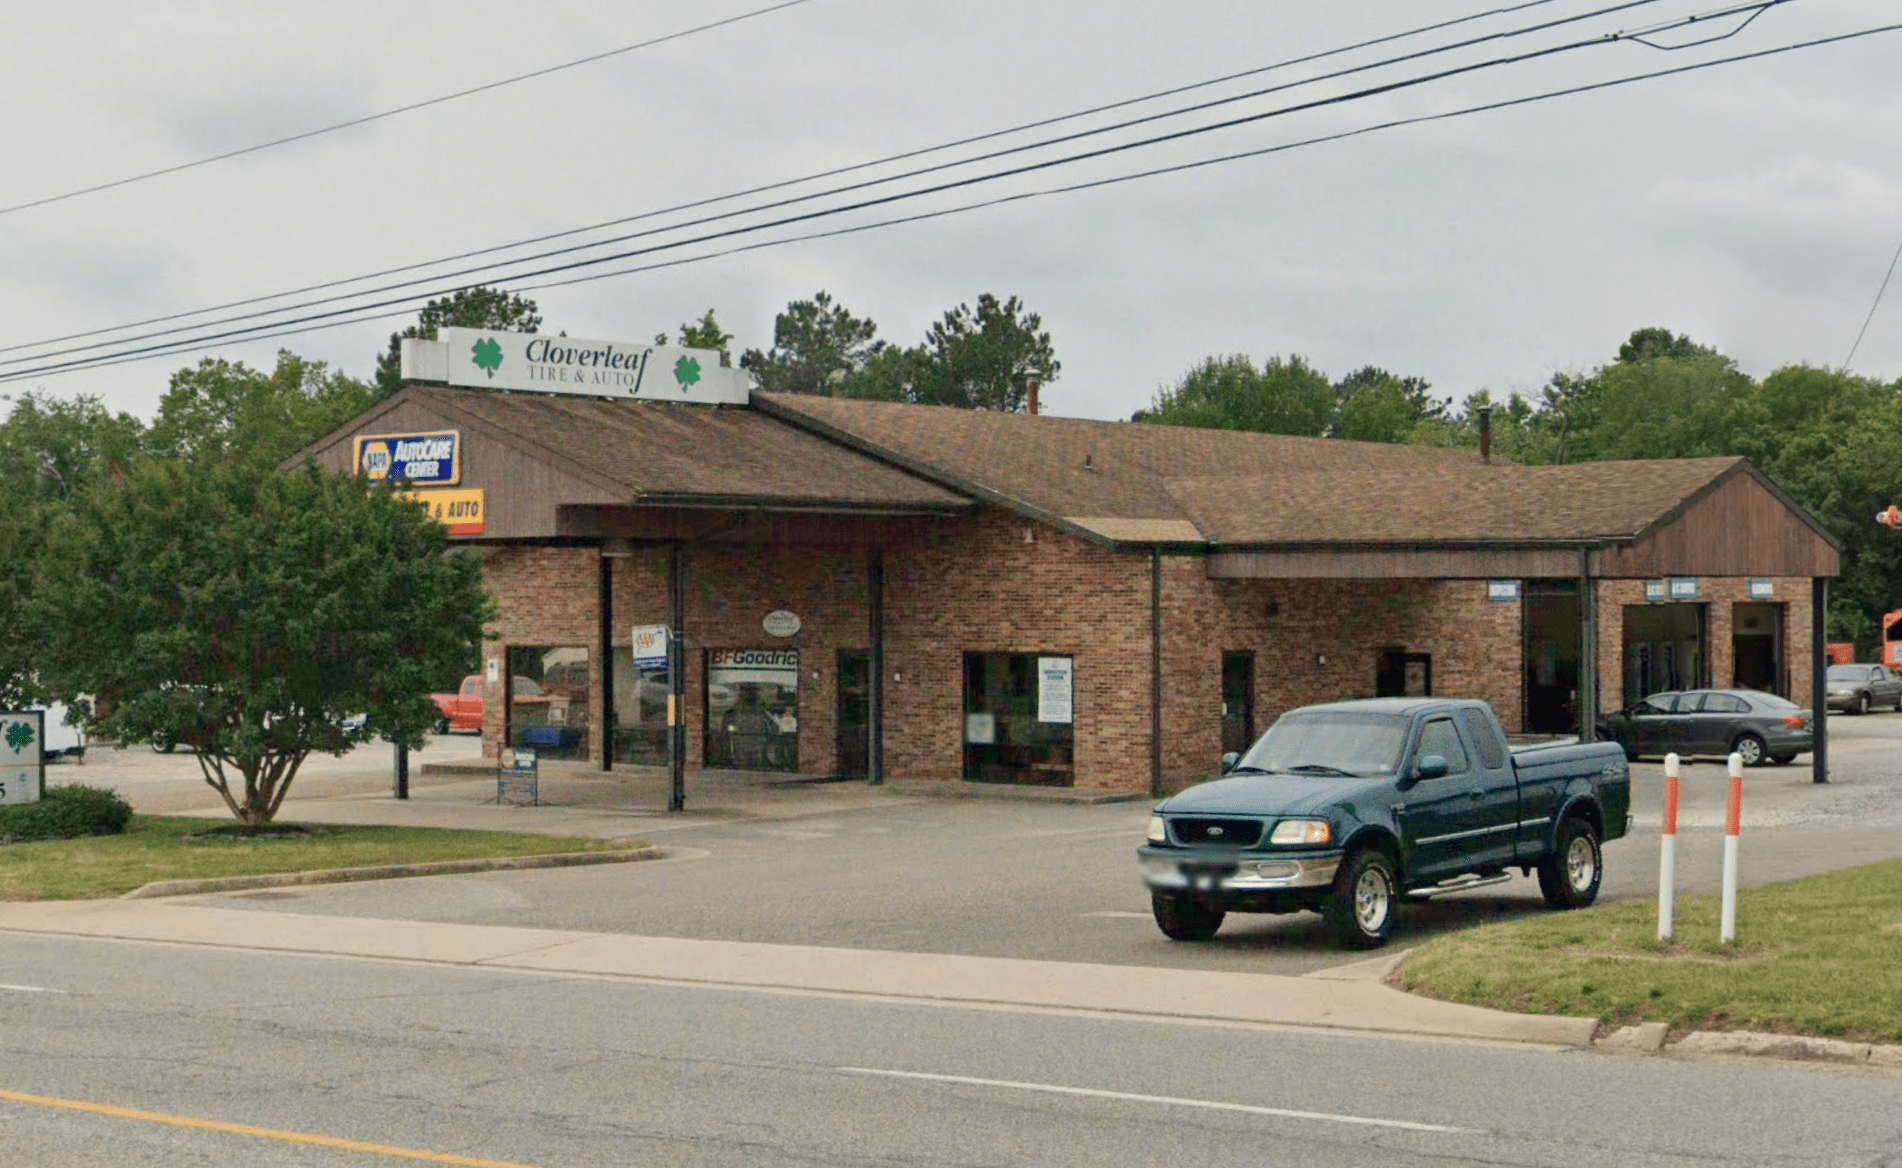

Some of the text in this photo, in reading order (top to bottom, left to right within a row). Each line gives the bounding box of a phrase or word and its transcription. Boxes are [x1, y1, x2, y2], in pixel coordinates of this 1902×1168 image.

[526, 339, 653, 394] Cloverleaf
[527, 365, 635, 387] TIRE & AUTO
[404, 461, 440, 478] CENTER
[448, 501, 480, 518] AUTO
